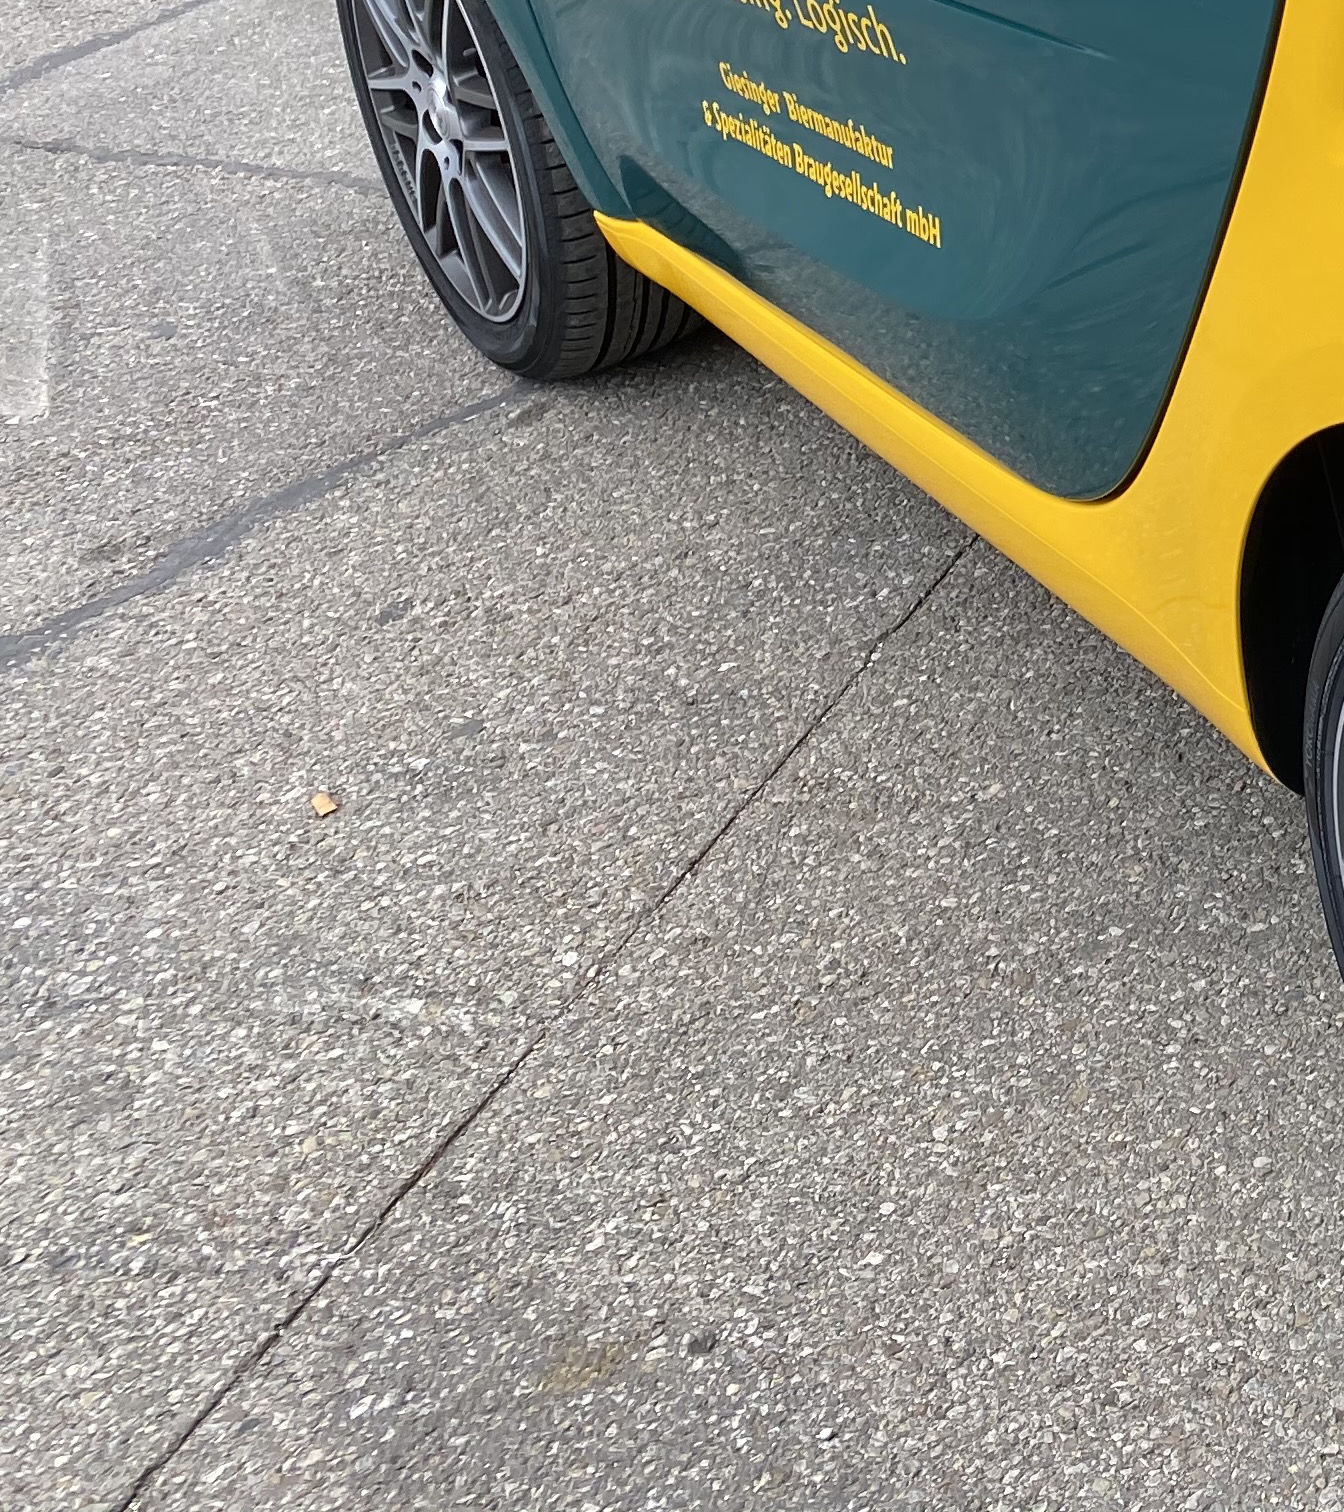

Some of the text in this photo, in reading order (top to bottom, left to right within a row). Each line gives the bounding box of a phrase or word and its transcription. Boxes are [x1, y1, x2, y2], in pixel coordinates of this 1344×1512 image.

[713, 101, 793, 169] Spezialitäten
[793, 142, 903, 229] Braugesellschaft
[905, 205, 942, 249] mbH
[718, 60, 894, 170] Giesinger Biermanufaktur
